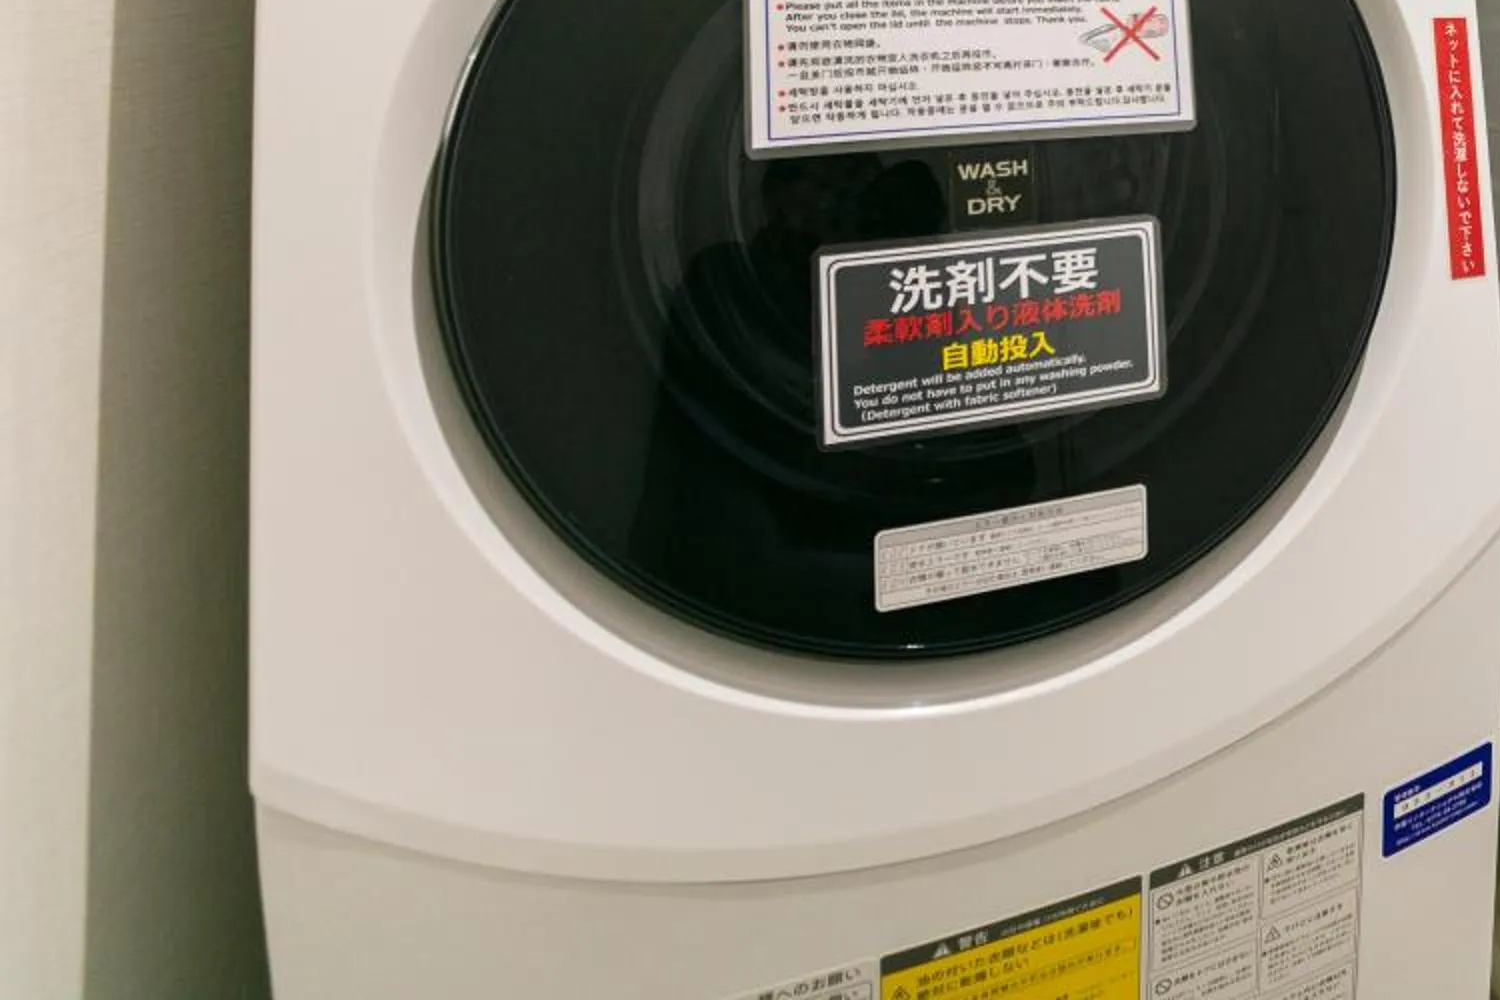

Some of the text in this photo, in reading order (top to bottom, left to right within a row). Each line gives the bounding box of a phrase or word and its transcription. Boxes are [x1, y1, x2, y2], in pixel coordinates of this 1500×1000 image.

[785, 1, 821, 10] Please
[785, 12, 813, 22] After
[786, 24, 807, 33] You
[1444, 23, 1475, 272] ネットに入れて洗濯しないで下さい
[957, 160, 1028, 180] WASH
[986, 180, 1001, 195] &
[967, 195, 1022, 215] DRY
[889, 247, 1098, 314] 洗剤不要
[863, 289, 1121, 347] 柔軟剤入り液体洗剤
[942, 332, 1055, 371] 自動投入
[854, 377, 918, 397] Detergent
[921, 372, 944, 387] will
[947, 370, 961, 384] be
[964, 365, 1002, 382] added
[854, 358, 1134, 410] You do not have to put in any washing powder.
[861, 382, 1057, 423] (Detergent with fabric softener)
